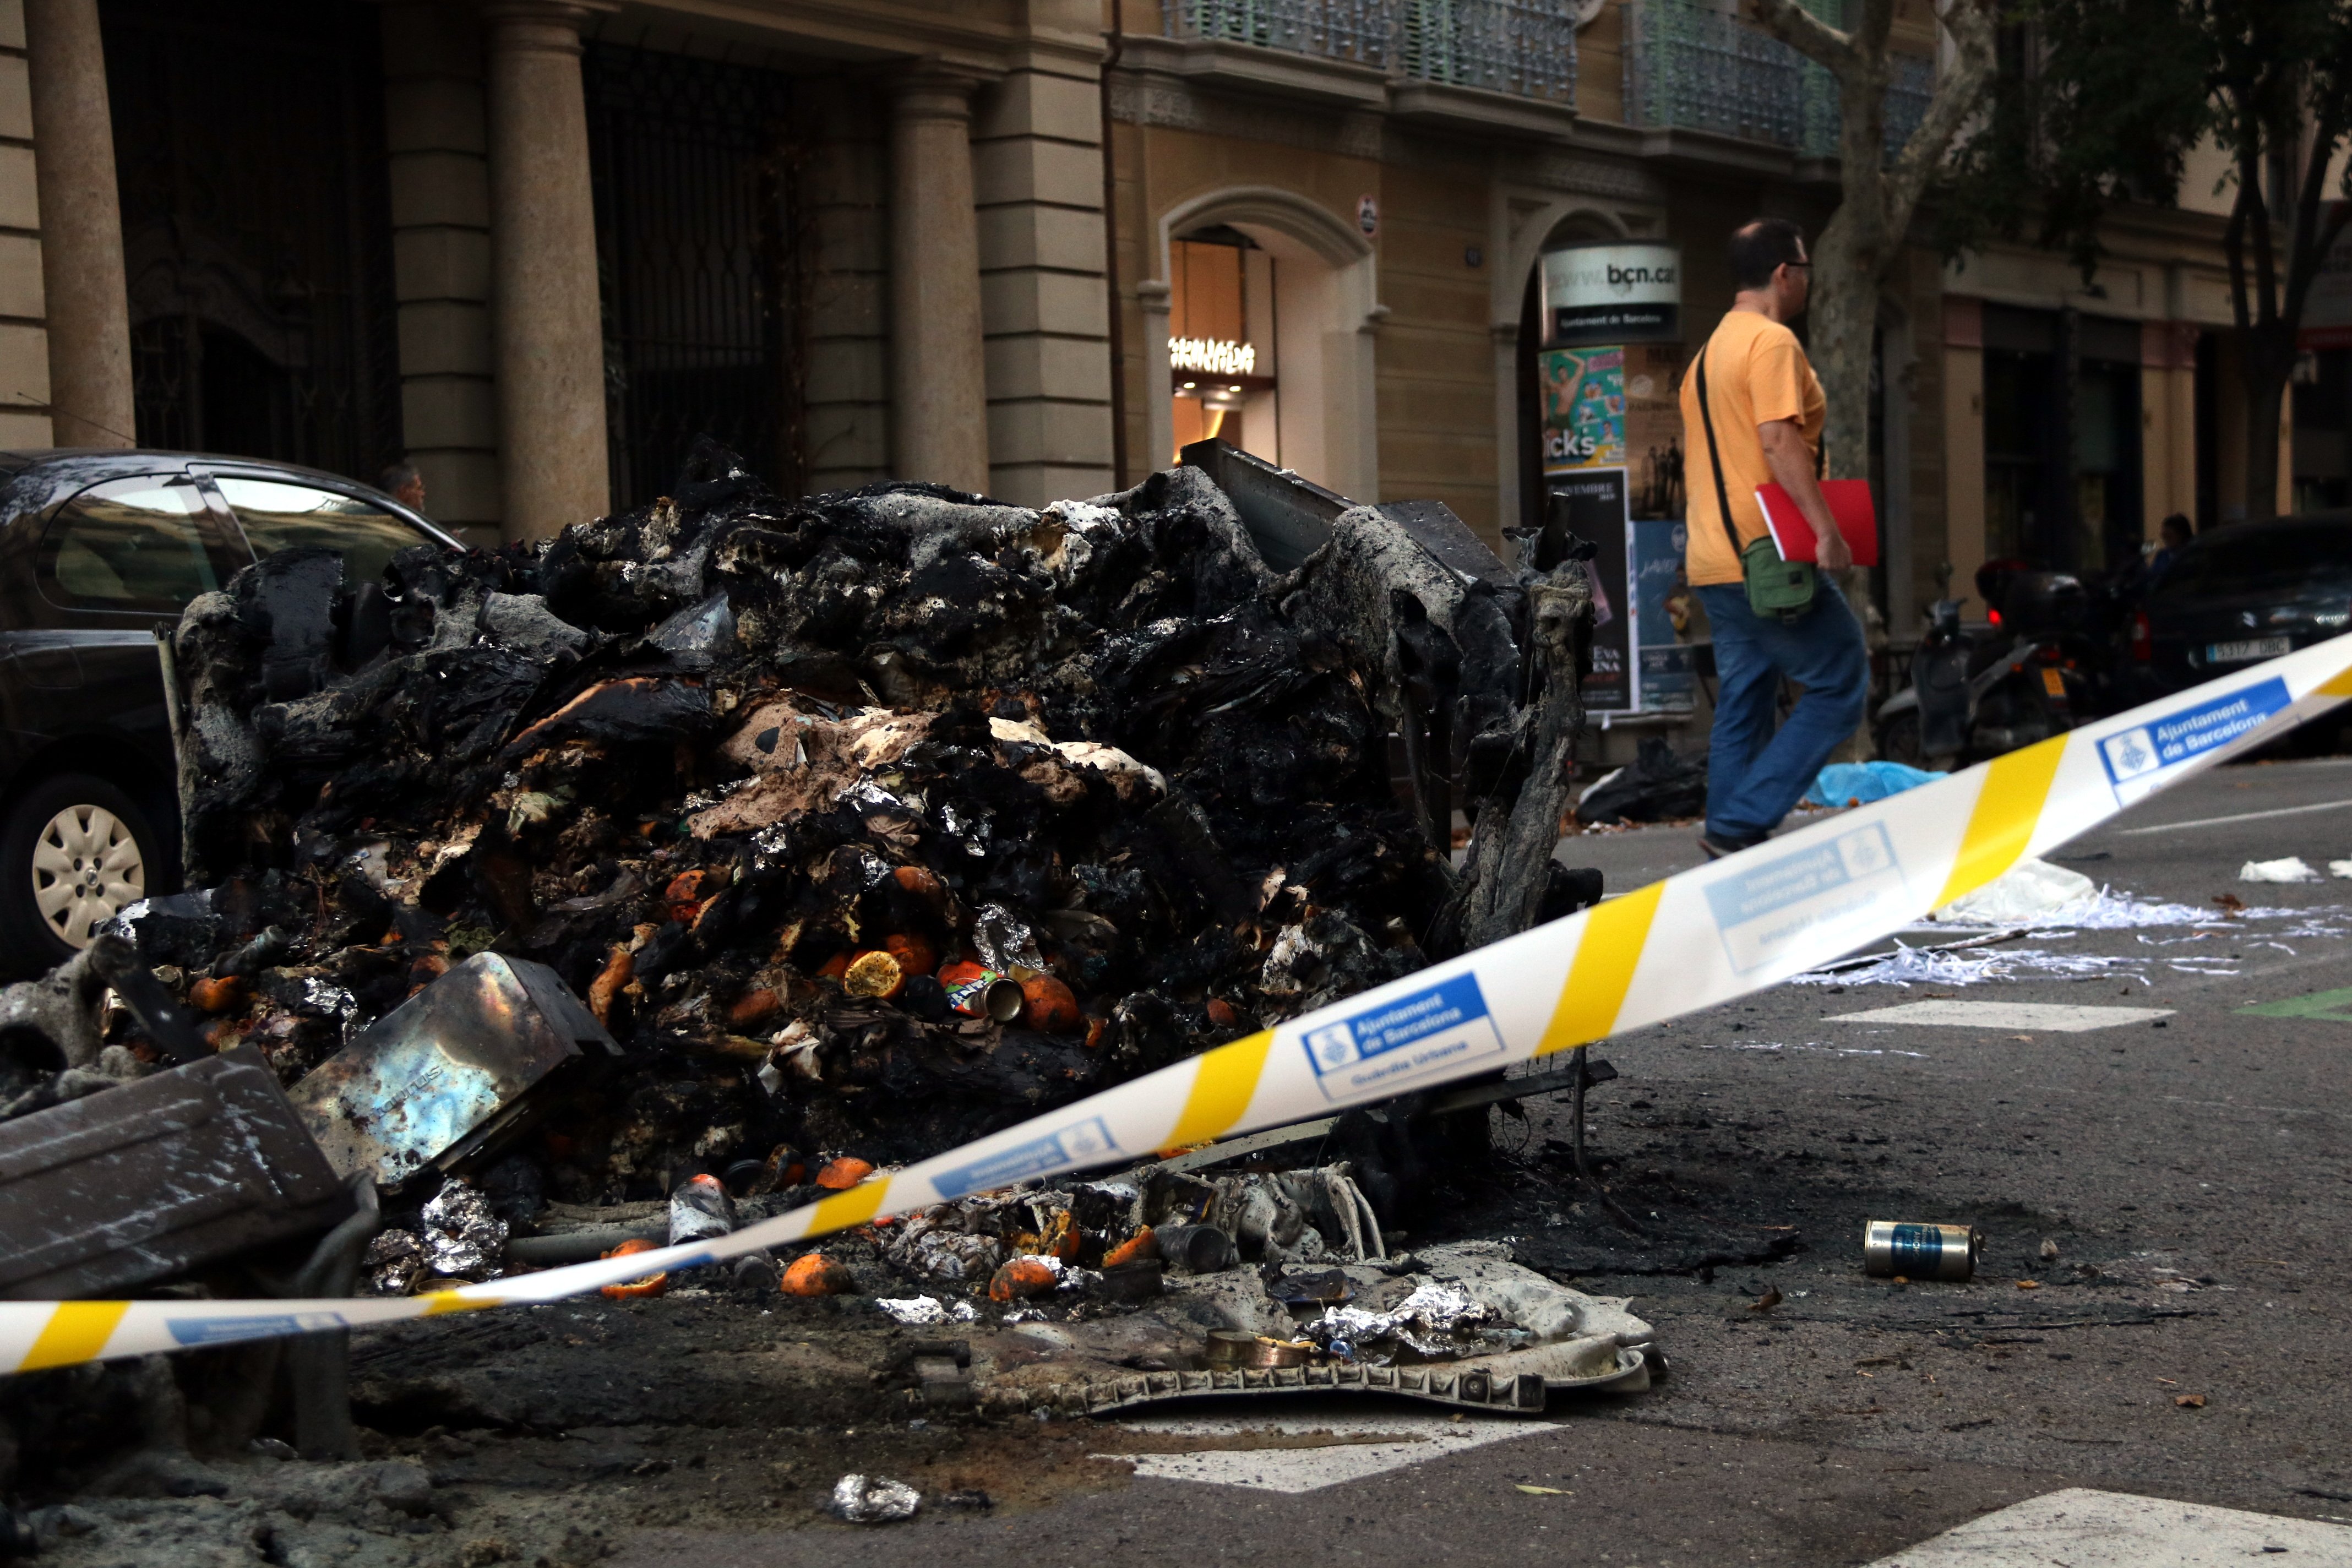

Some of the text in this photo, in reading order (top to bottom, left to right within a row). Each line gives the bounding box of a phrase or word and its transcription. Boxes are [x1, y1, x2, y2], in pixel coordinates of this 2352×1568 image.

[2157, 699, 2247, 742] Ajuntament
[2162, 713, 2267, 760] de Barcelona
[1357, 993, 1444, 1036] Ajuntament
[1363, 1007, 1462, 1052] de Barcelona
